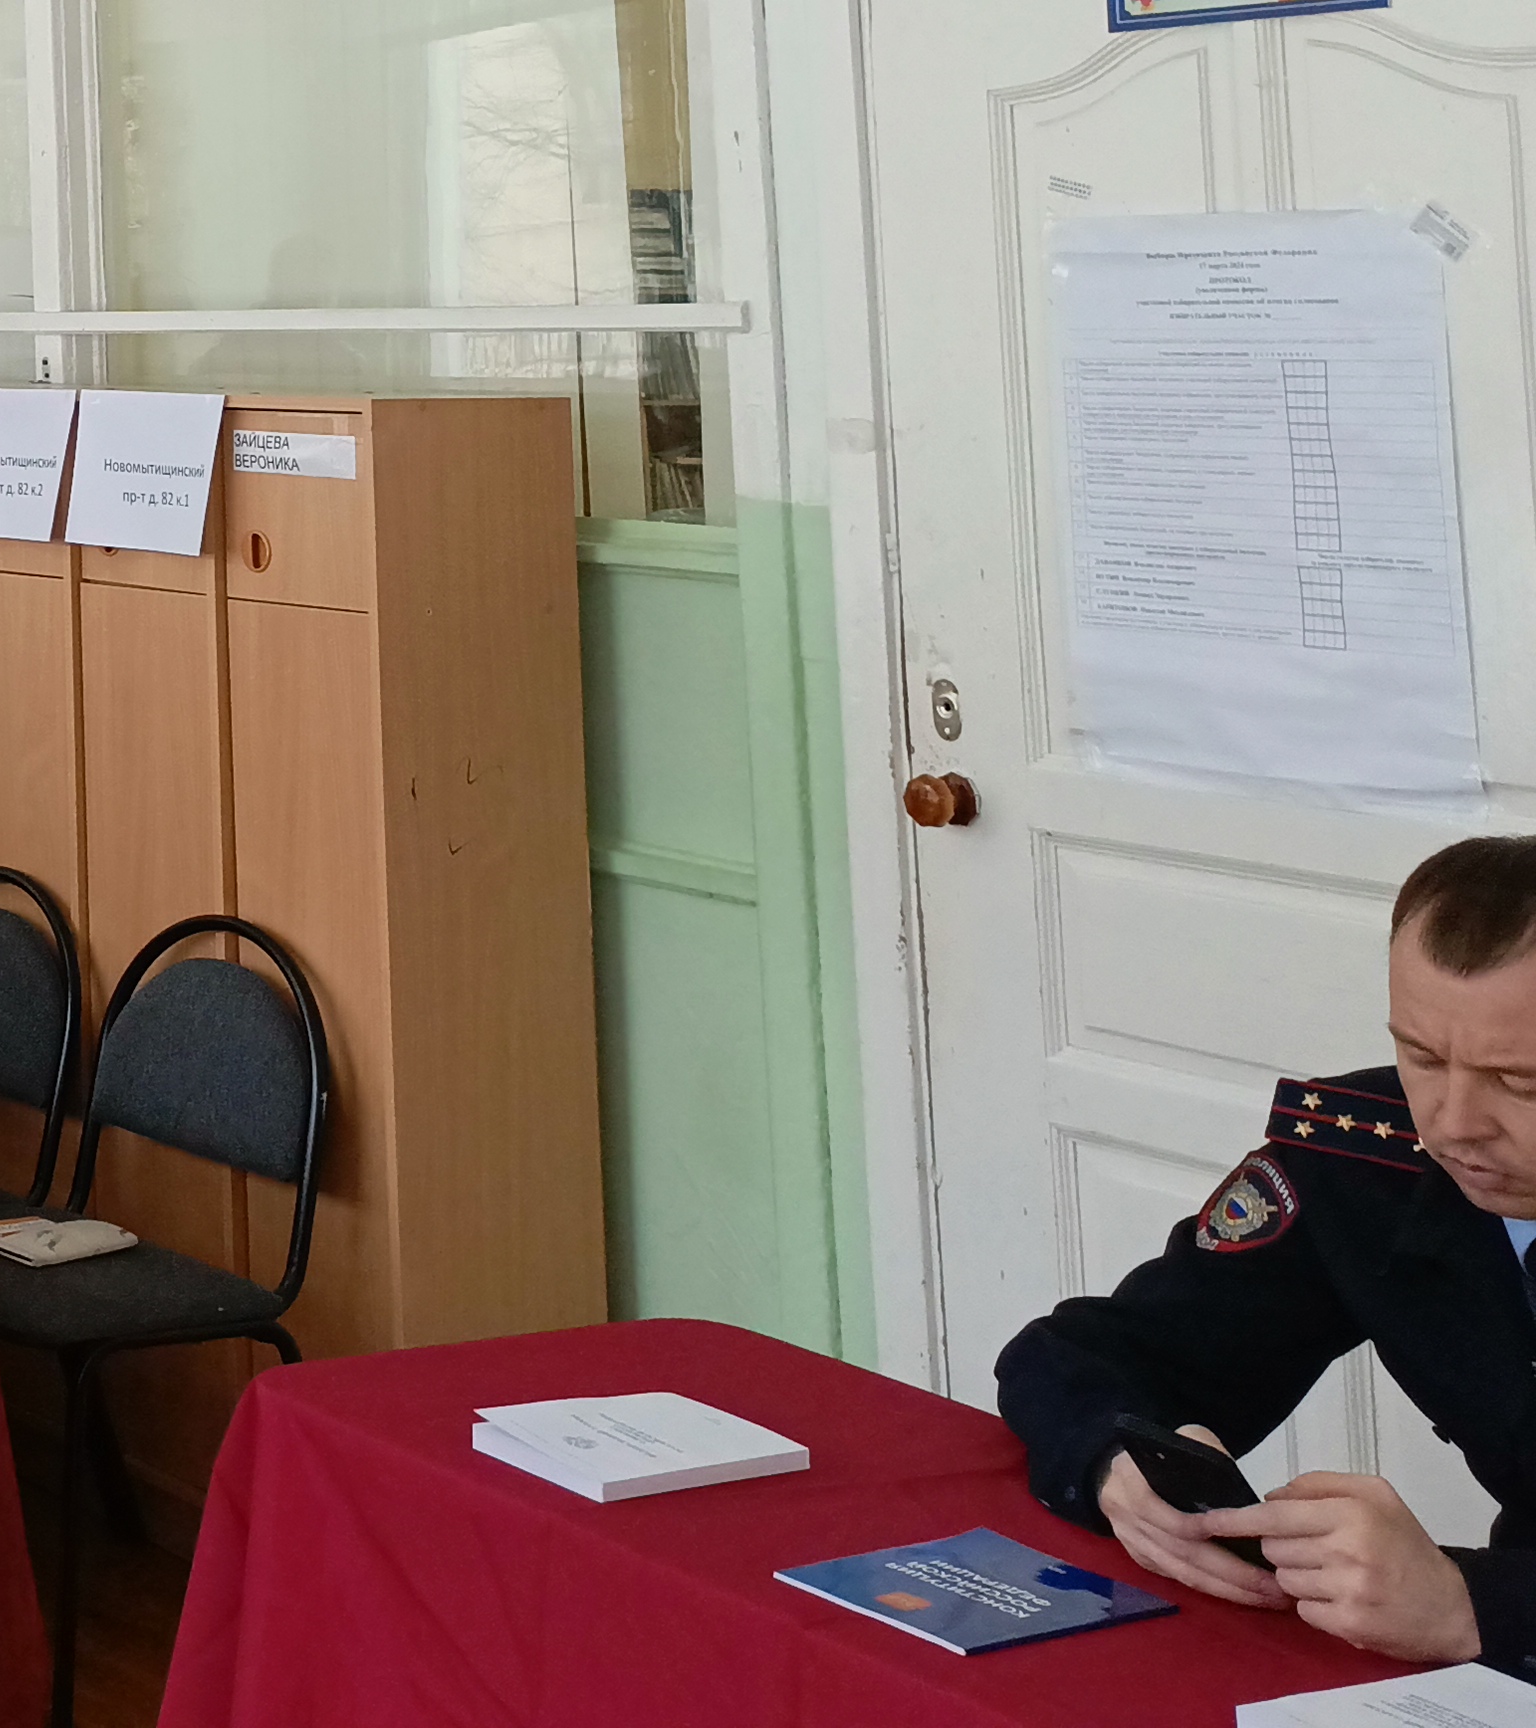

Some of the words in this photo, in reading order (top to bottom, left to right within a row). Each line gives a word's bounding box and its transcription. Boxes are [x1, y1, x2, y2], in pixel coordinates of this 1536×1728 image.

[234, 432, 290, 452] ЗАЙЦЕВА
[104, 458, 205, 479] Новомытищинский
[234, 453, 301, 472] ВЕРОНИКА
[5, 483, 16, 498] д.
[17, 482, 29, 497] 82
[122, 491, 146, 505] пр-т
[148, 492, 160, 507] д.
[161, 491, 174, 507] 82
[176, 493, 190, 508] к.1
[884, 1561, 1031, 1620] КОНСТИТУЦИЯ
[906, 1560, 1042, 1614] РОССИЙСКОЙ
[929, 1559, 1053, 1608] ФЕДЕРАЦИИ
